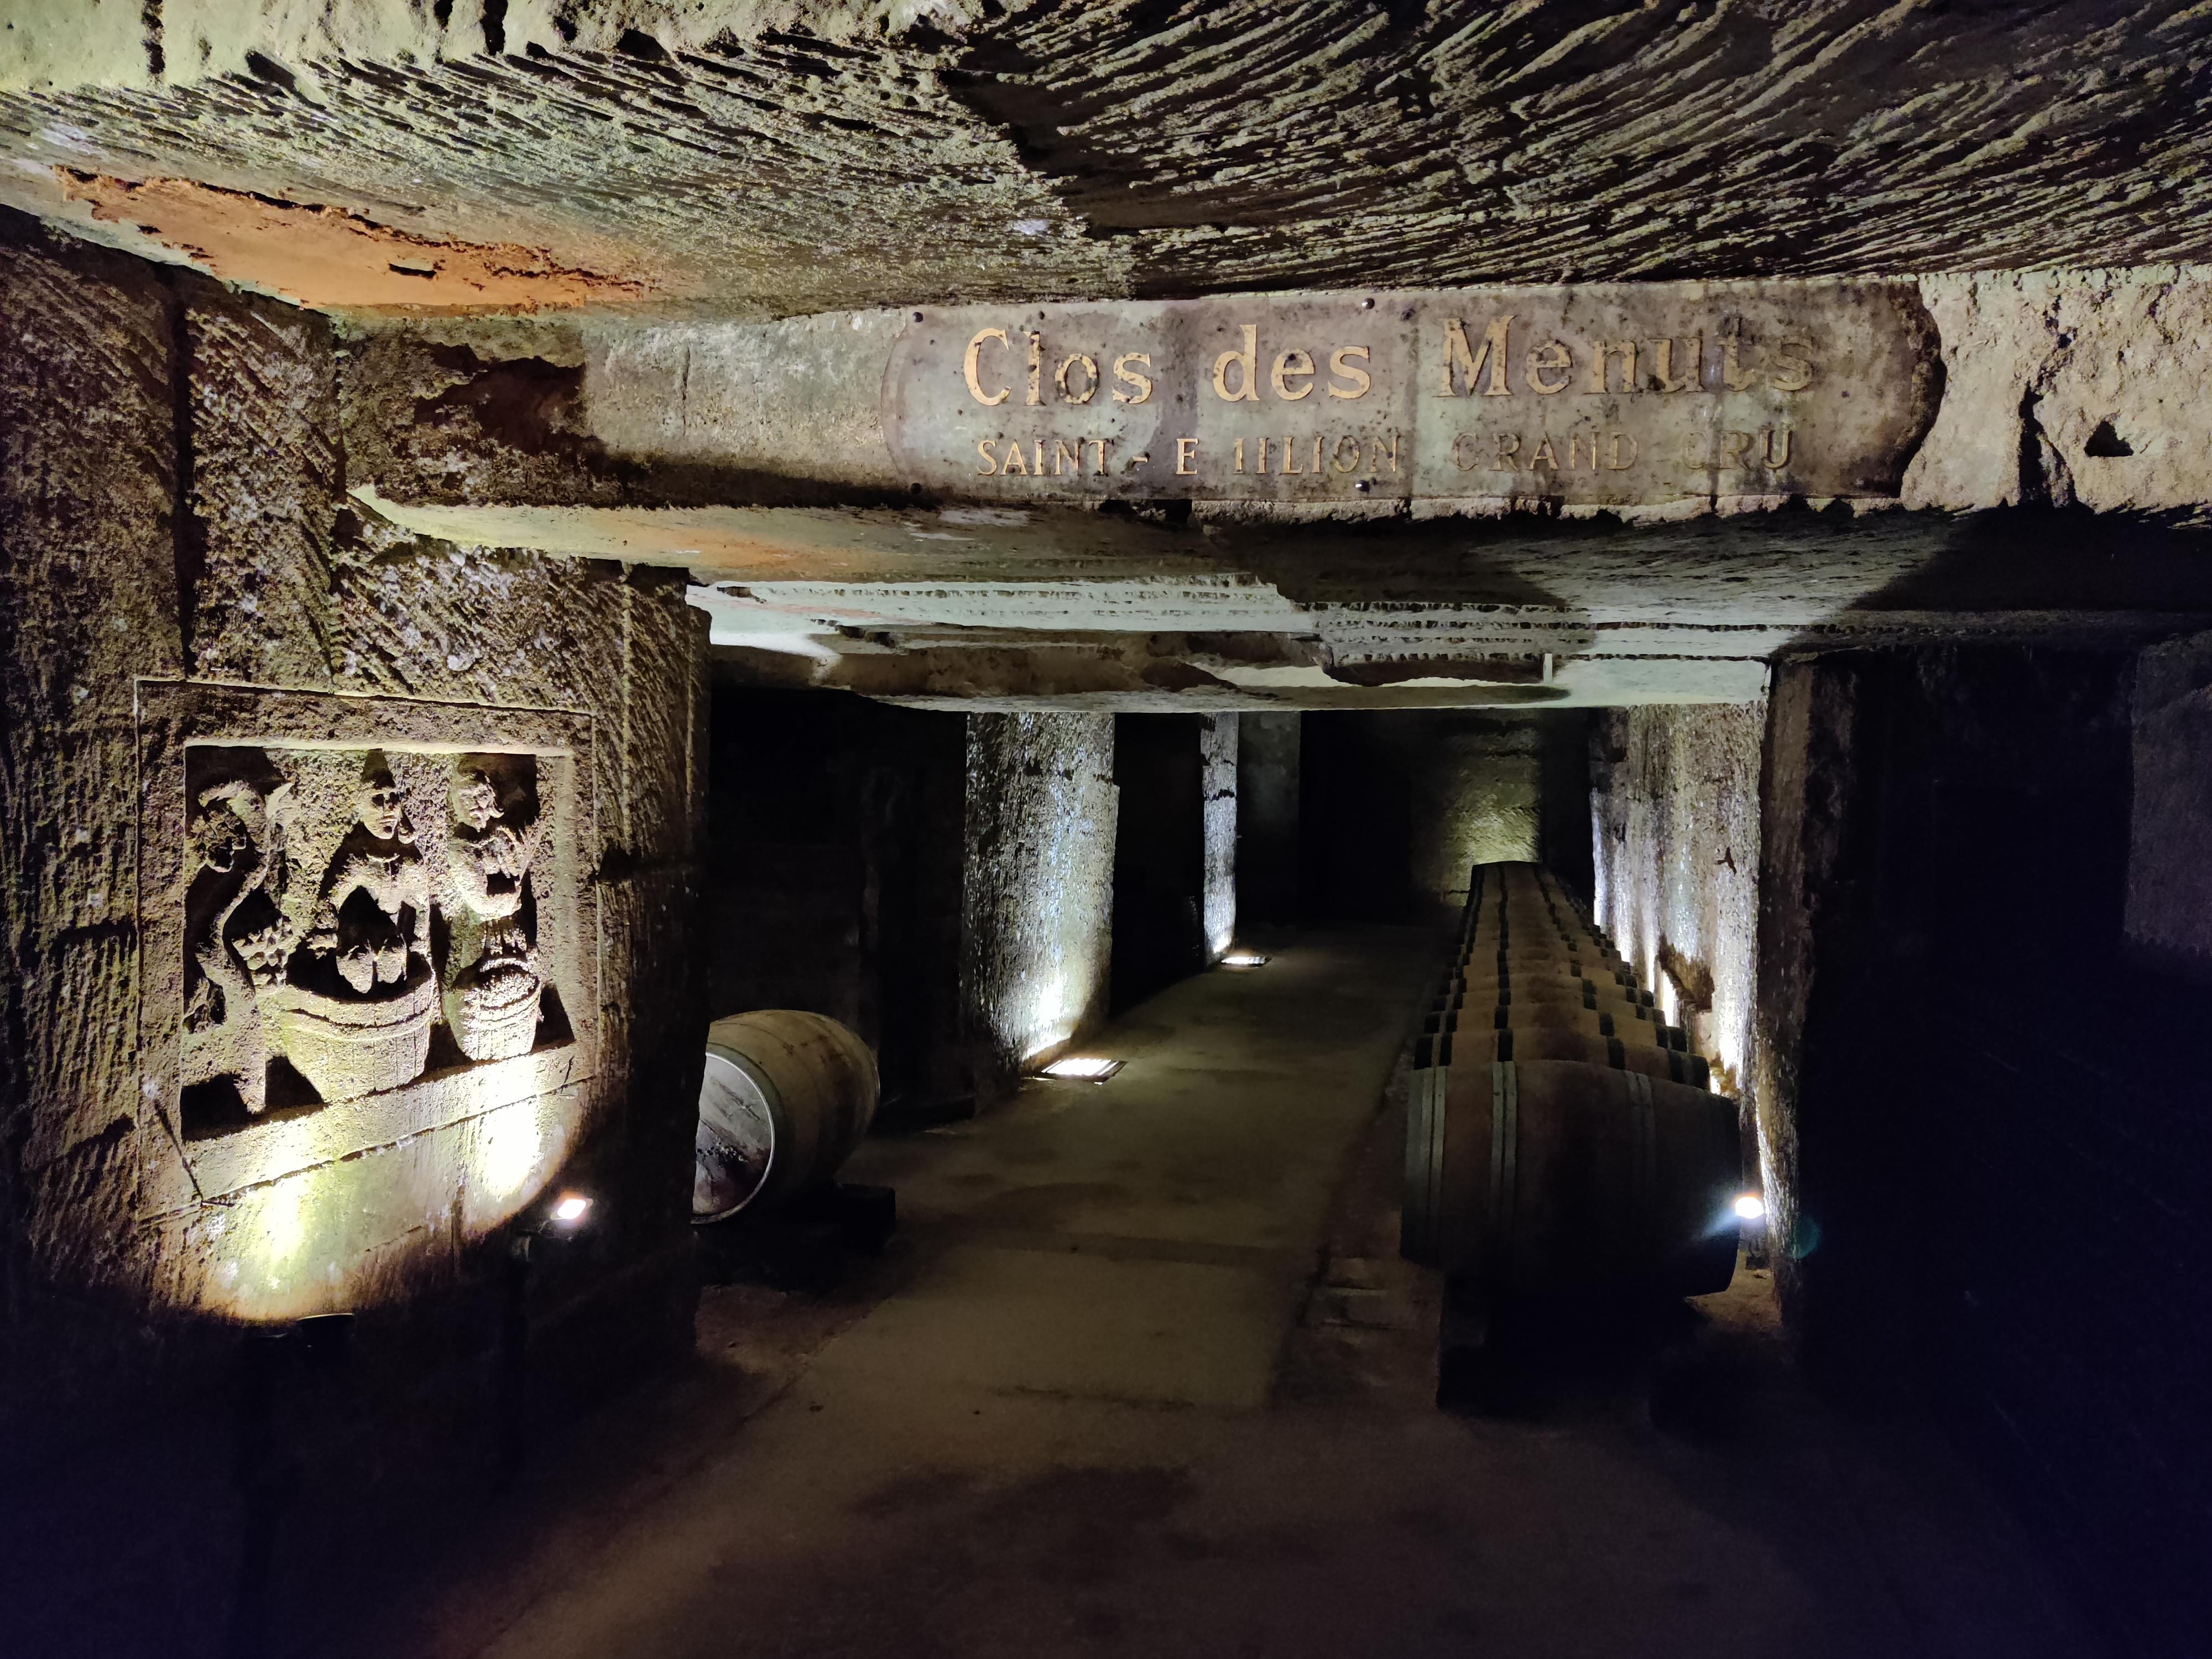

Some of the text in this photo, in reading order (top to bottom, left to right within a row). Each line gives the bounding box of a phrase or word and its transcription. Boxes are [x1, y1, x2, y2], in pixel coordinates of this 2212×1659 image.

[964, 314, 1814, 406] Clos des Menuts
[1176, 435, 1399, 474] EILION
[1682, 429, 1793, 470] CRU
